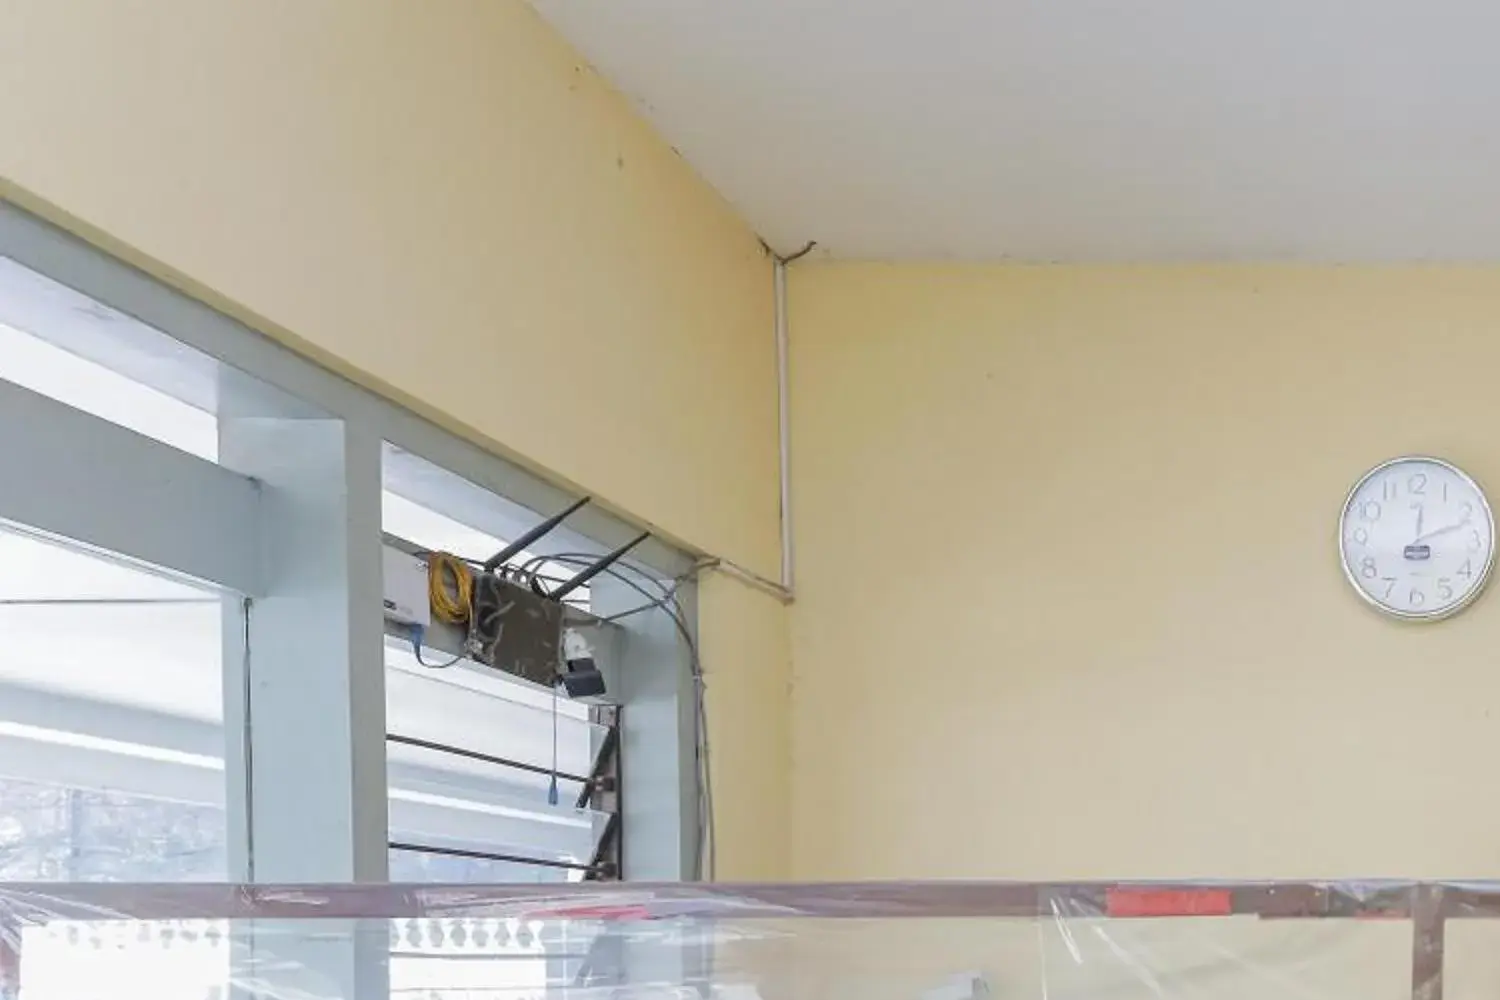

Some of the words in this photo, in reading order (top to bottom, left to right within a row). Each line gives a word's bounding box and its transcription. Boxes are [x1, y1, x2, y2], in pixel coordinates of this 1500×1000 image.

[1407, 473, 1427, 495] 12
[1361, 557, 1377, 578] 8
[1457, 559, 1472, 579] 4
[1381, 577, 1398, 599] 7
[1409, 588, 1425, 606] 6
[1437, 578, 1453, 600] 5
